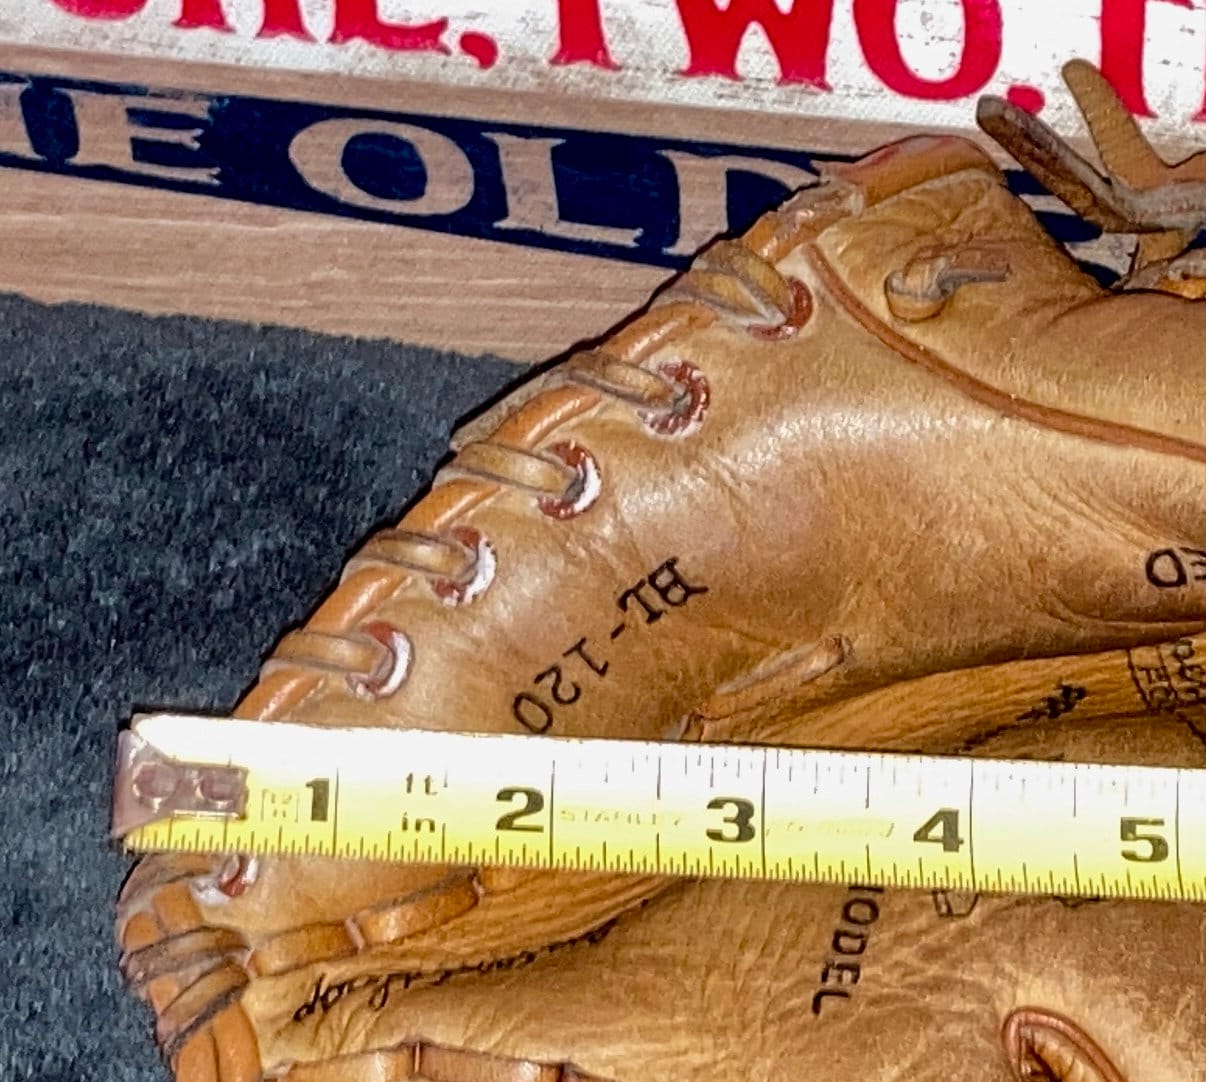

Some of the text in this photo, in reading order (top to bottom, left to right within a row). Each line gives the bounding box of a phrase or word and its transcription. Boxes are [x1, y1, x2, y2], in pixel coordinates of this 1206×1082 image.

[305, 777, 329, 822] 1
[495, 787, 545, 833] 2
[705, 795, 756, 843] 3
[912, 807, 965, 852] 4
[1119, 816, 1170, 863] 5
[401, 811, 436, 833] in
[811, 884, 885, 1016] ODEL
